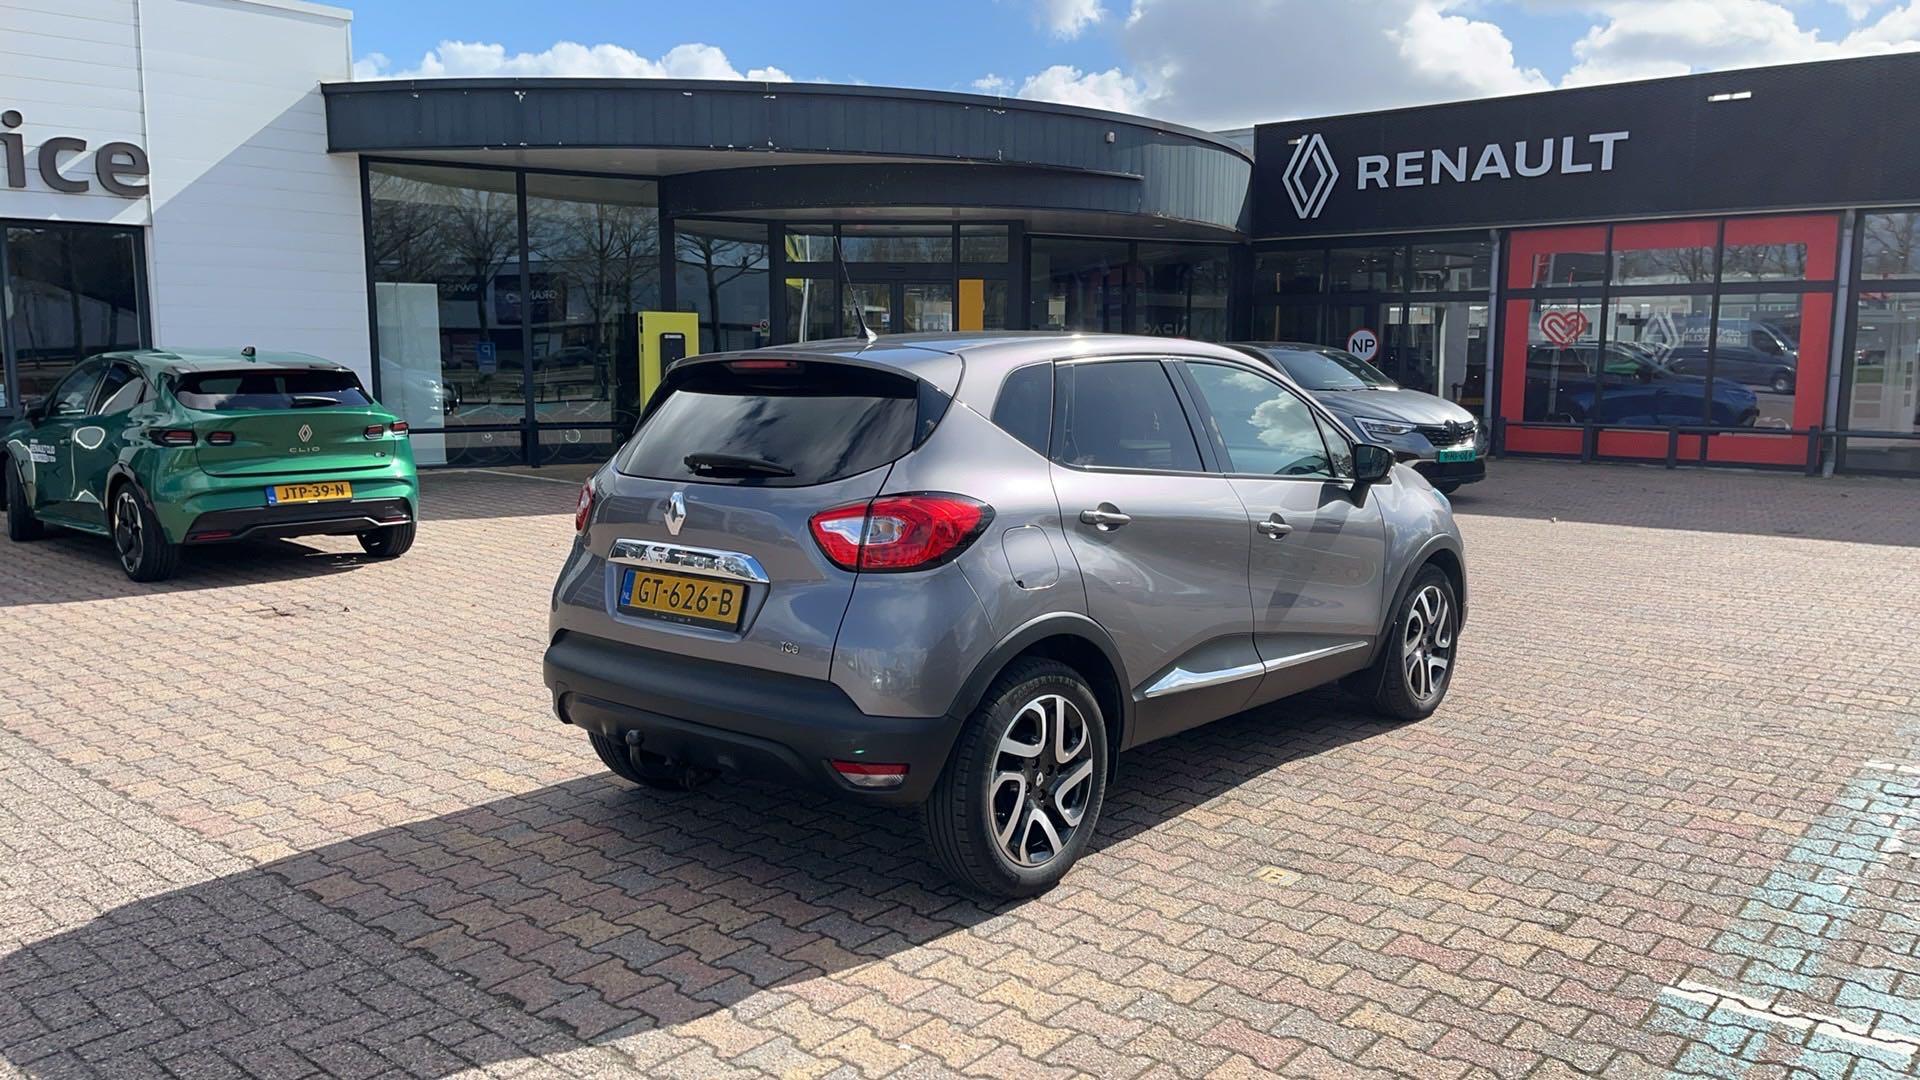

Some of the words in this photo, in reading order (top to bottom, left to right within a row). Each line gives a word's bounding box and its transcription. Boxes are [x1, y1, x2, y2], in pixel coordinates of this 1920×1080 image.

[1357, 131, 1629, 190] RENAULT
[1352, 339, 1375, 353] NP
[283, 484, 345, 500] JTP-39-N
[638, 577, 734, 616] GT-626-B
